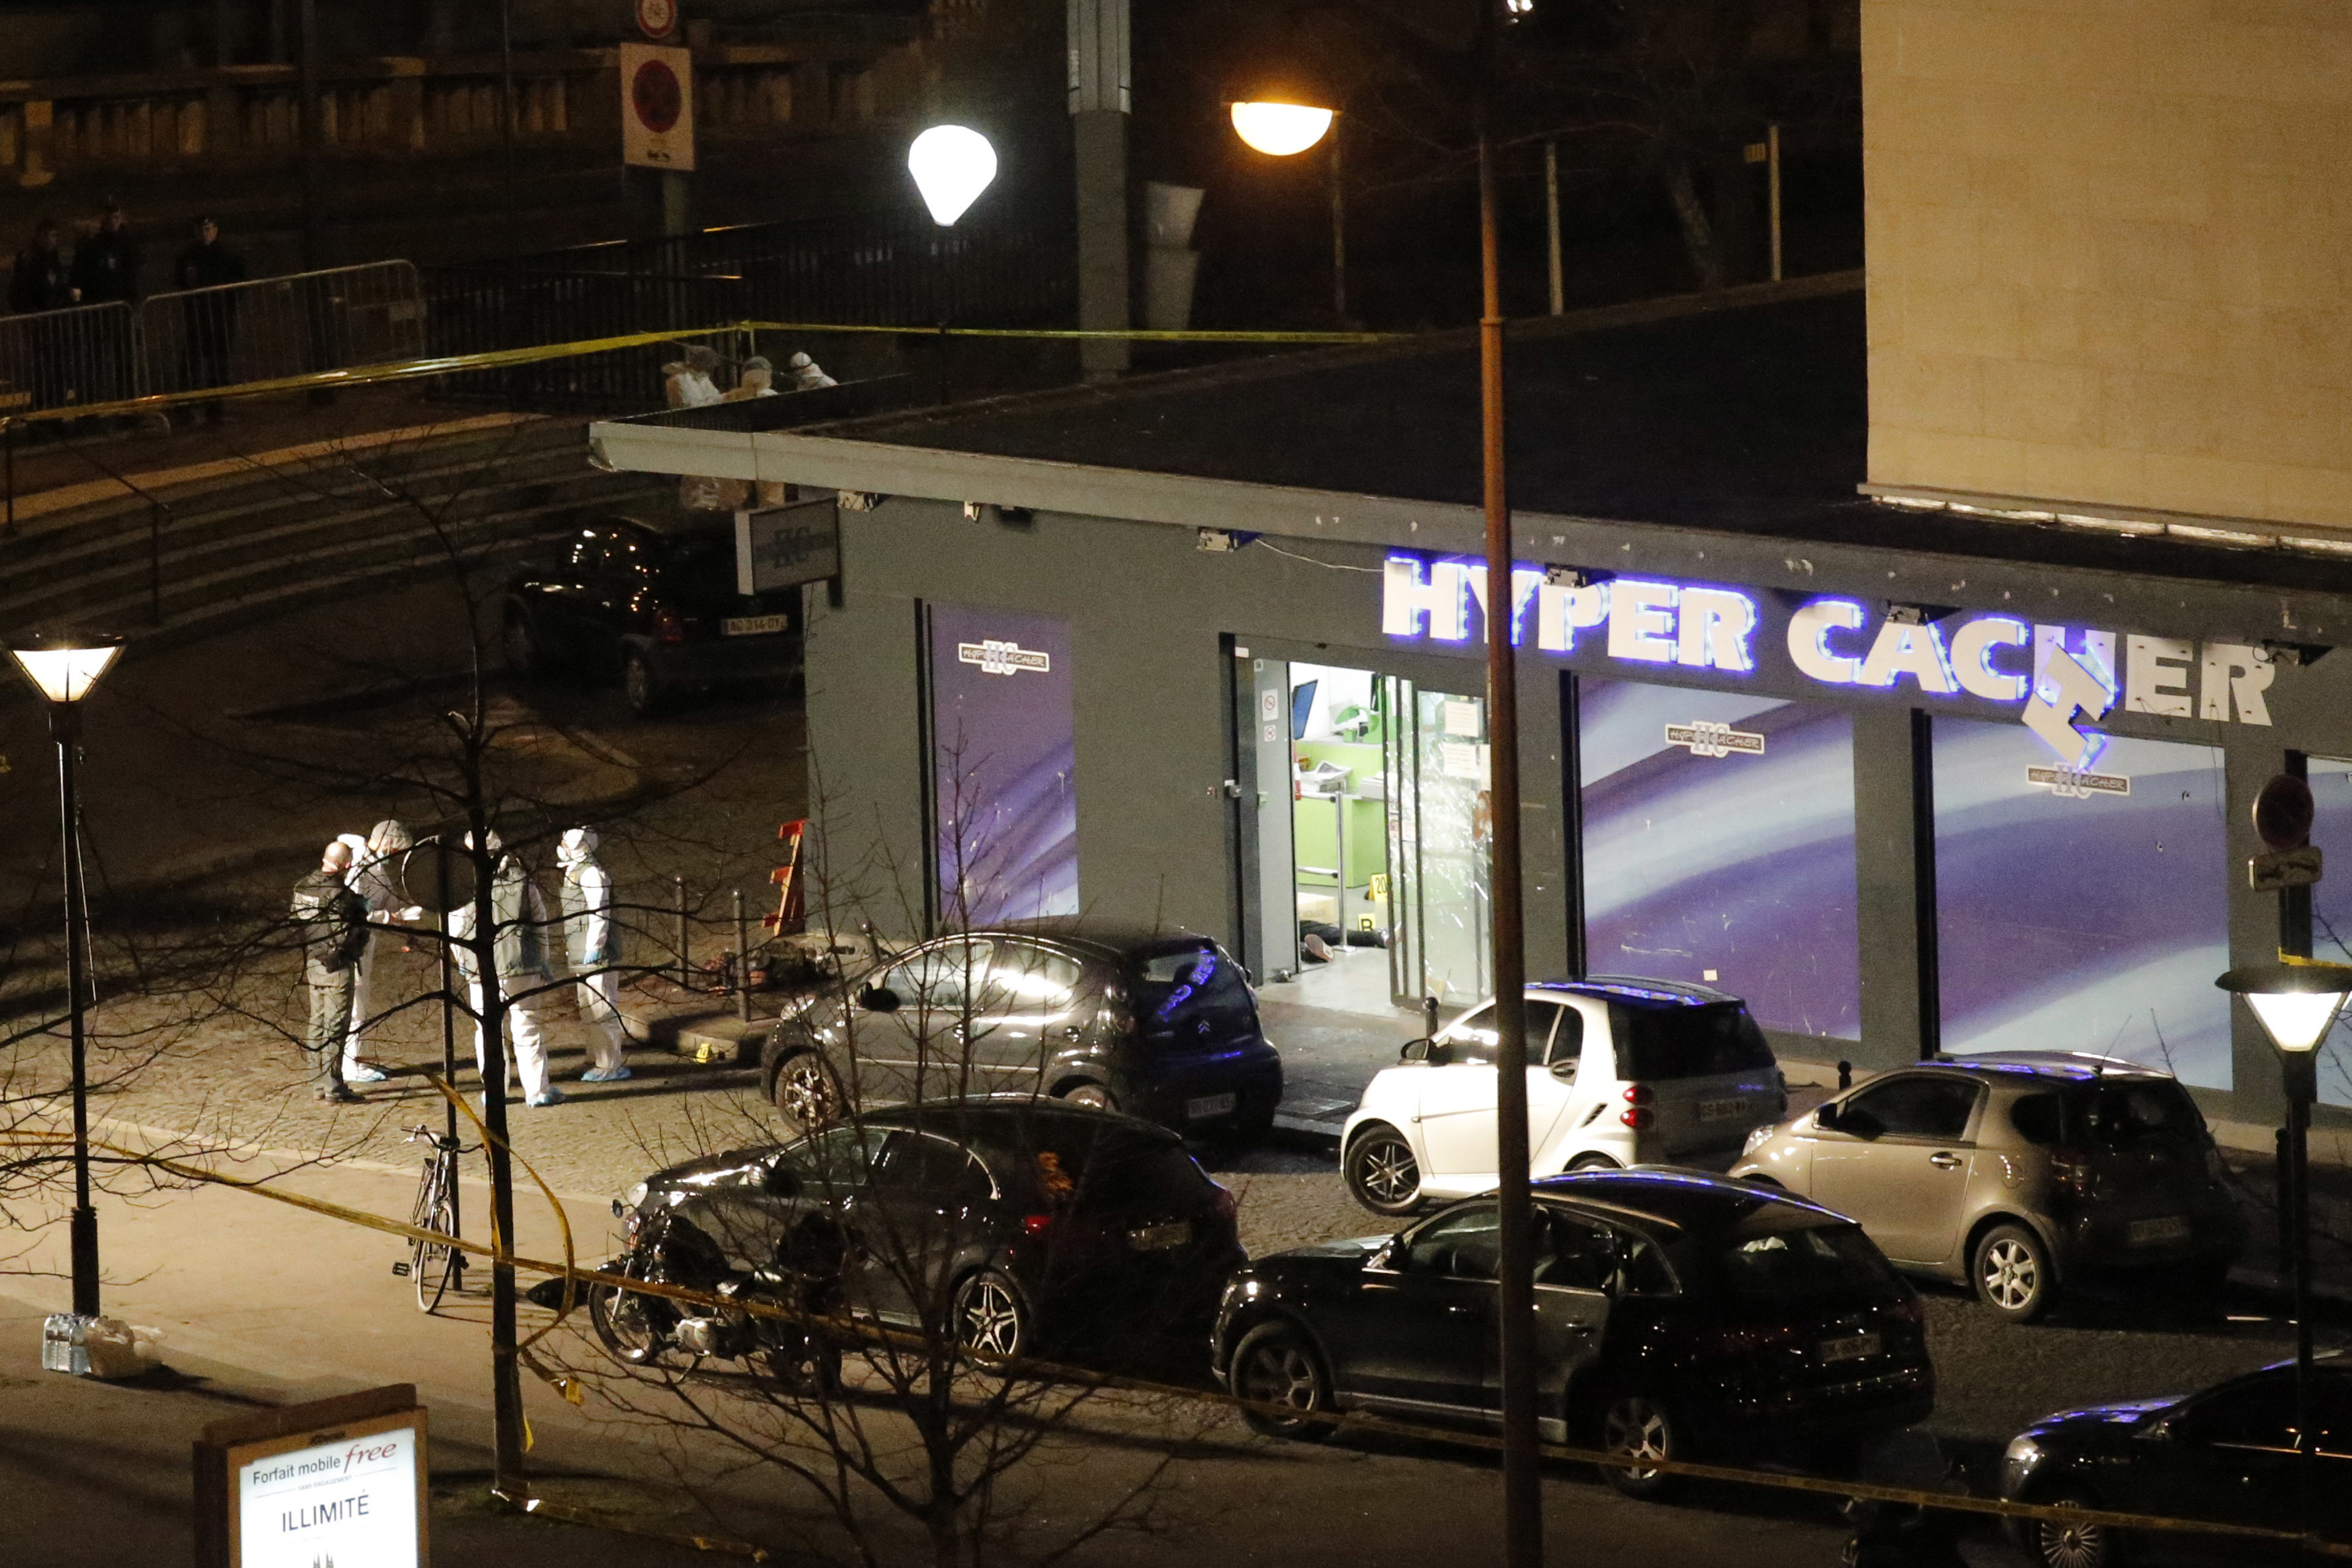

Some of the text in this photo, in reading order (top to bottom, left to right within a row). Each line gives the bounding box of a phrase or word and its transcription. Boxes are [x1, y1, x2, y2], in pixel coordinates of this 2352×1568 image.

[1382, 555, 2275, 727] HYPER CACHER
[1375, 876, 1387, 894] 20
[253, 1442, 397, 1486] Forfait mobile free
[298, 1476, 352, 1491] SANS ENGAGEMENT
[282, 1489, 369, 1533] ILLIMITÉ
